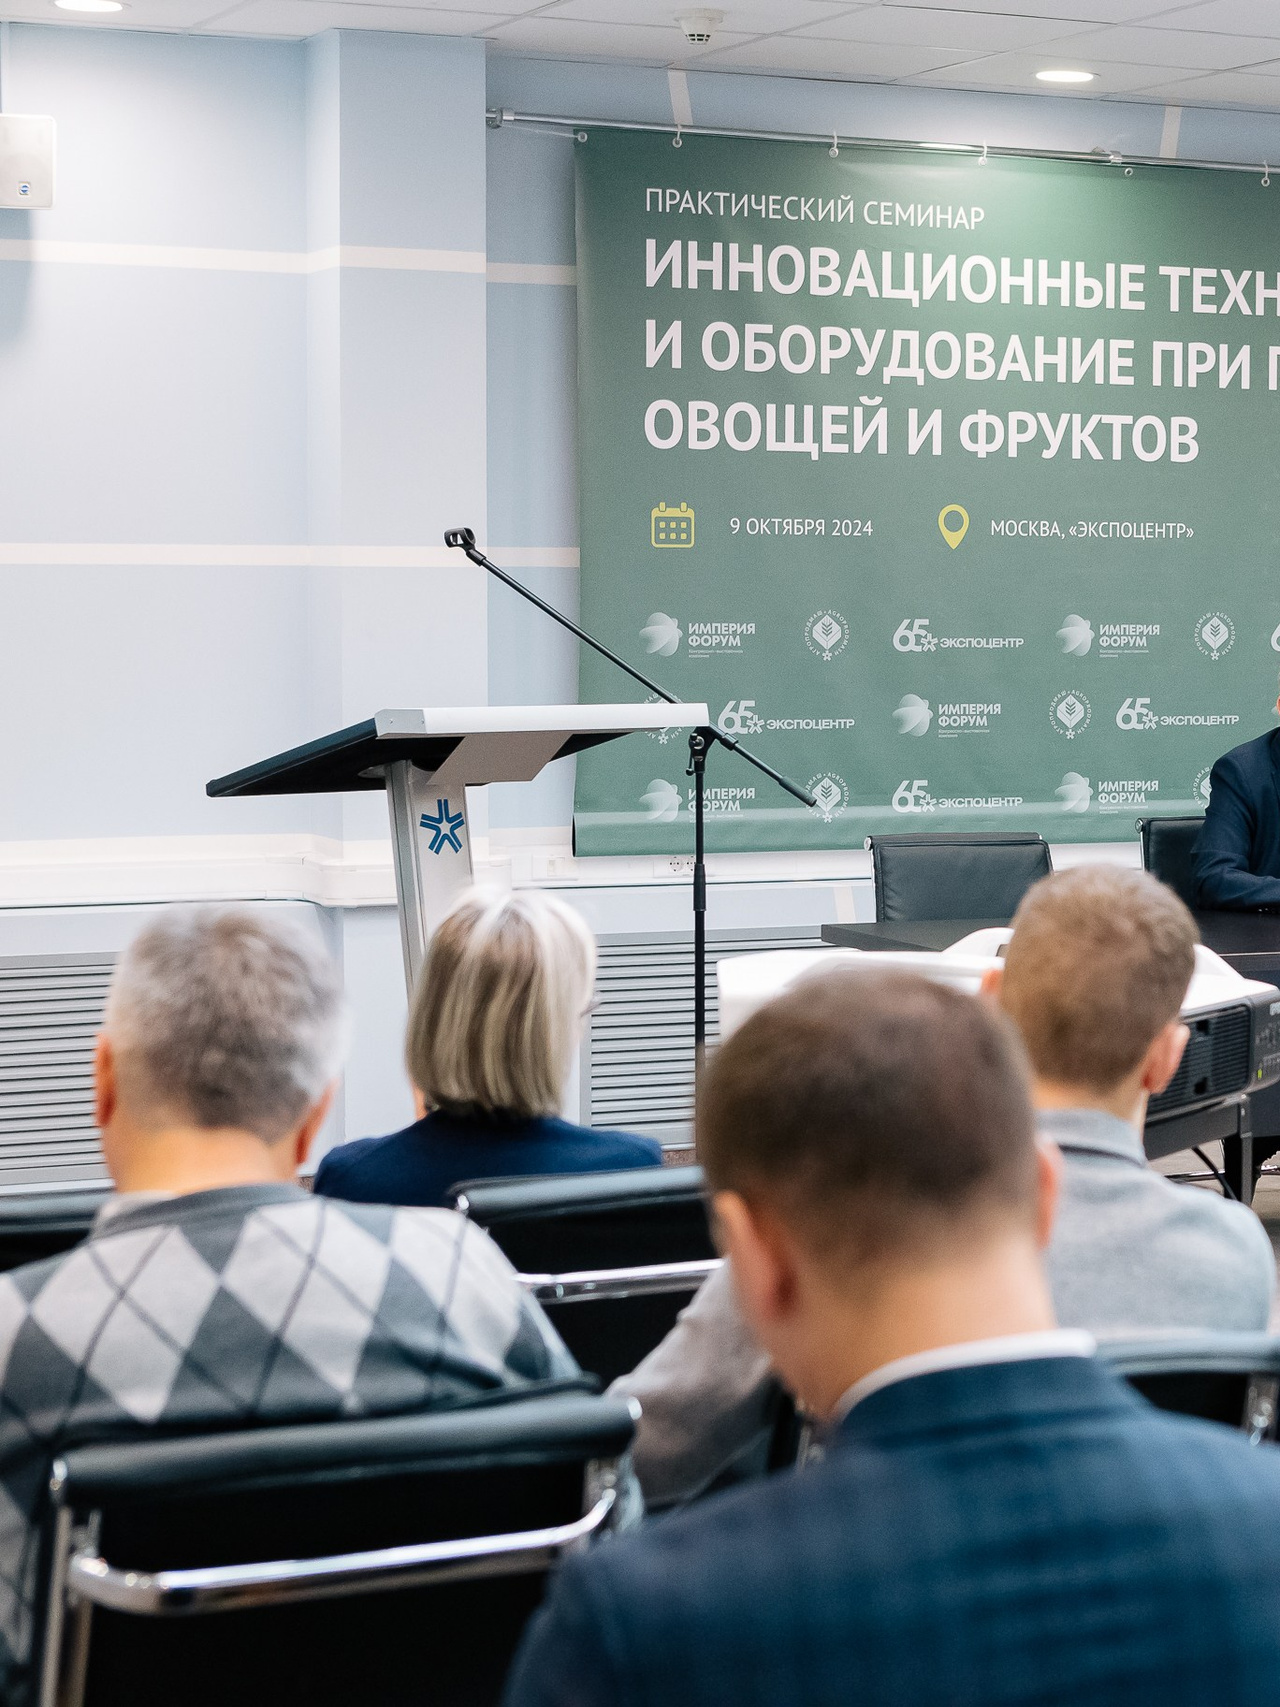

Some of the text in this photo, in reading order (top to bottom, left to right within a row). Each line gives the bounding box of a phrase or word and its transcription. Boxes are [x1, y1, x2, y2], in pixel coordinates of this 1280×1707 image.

[645, 187, 985, 230] ПРАКТИЧЕСКИЙ СЕМИНАР
[645, 238, 1146, 311] ИННОВАЦИОННЫЕ
[645, 319, 682, 369] И
[701, 321, 1135, 386] ОБОРУДОВАНИЕ
[1152, 340, 1251, 390] ПРИ
[644, 396, 1199, 463] ОВОЩЕЙ И ФРУКТОВ
[730, 517, 874, 537] 9 ОКТЯБРЯ 2024
[991, 519, 1195, 541] МОСКВА, «ЭКСПОЦЕНТР»
[688, 622, 756, 635] ИМПЕРИЯ
[892, 618, 1025, 653] 65 ЭКСПОЦЕНТР
[1099, 624, 1160, 636] ИМПЕРИЯ
[688, 635, 741, 647] ФОРУМ
[1099, 635, 1147, 647] ФОРУМ
[717, 699, 855, 735] 65 ЭКСПОЦЕНТР
[938, 703, 1002, 715] ИМПЕРИЯ
[1115, 697, 1240, 731] 65 ЭКСПОЦЕНТР
[938, 715, 988, 728] ФОРУМ
[688, 787, 756, 800] ИМПЕРИЯ
[1098, 780, 1159, 793] ИМПЕРИЯ
[891, 779, 1023, 814] 65 ЭКСПОЦЕНТР
[1097, 792, 1146, 804] ФОРУМ
[687, 800, 741, 813] ФОРУМ
